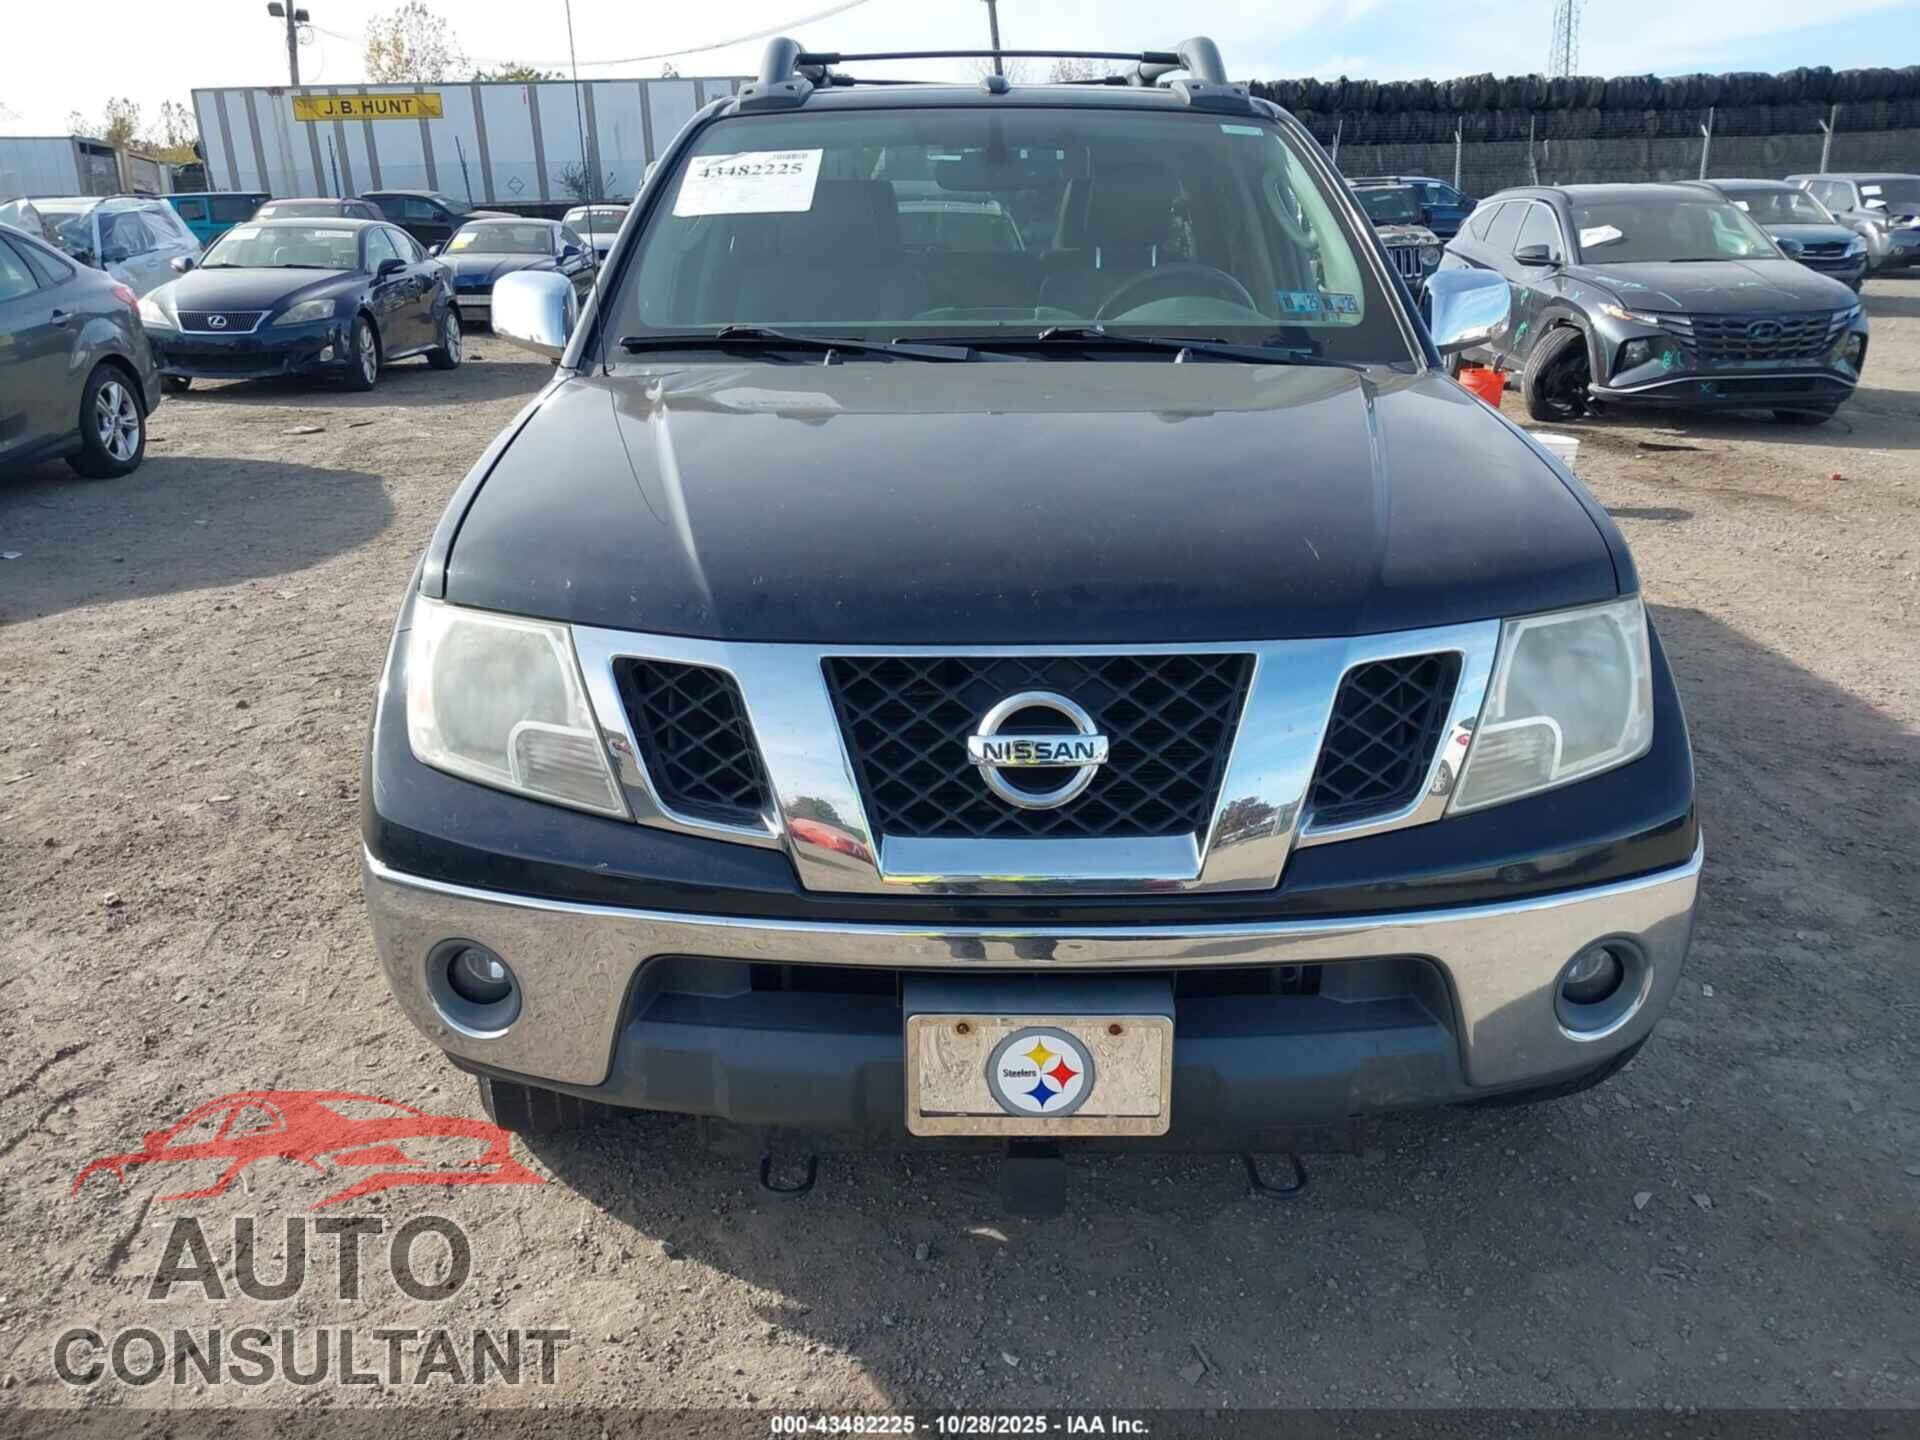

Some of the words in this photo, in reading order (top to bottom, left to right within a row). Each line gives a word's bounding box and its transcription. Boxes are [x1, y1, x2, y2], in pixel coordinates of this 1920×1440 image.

[324, 101, 357, 115] J.B.
[362, 99, 412, 114] HUNT
[698, 162, 803, 178] 43482225
[983, 740, 1094, 760] NISSAN
[1003, 1068, 1037, 1078] Steelers
